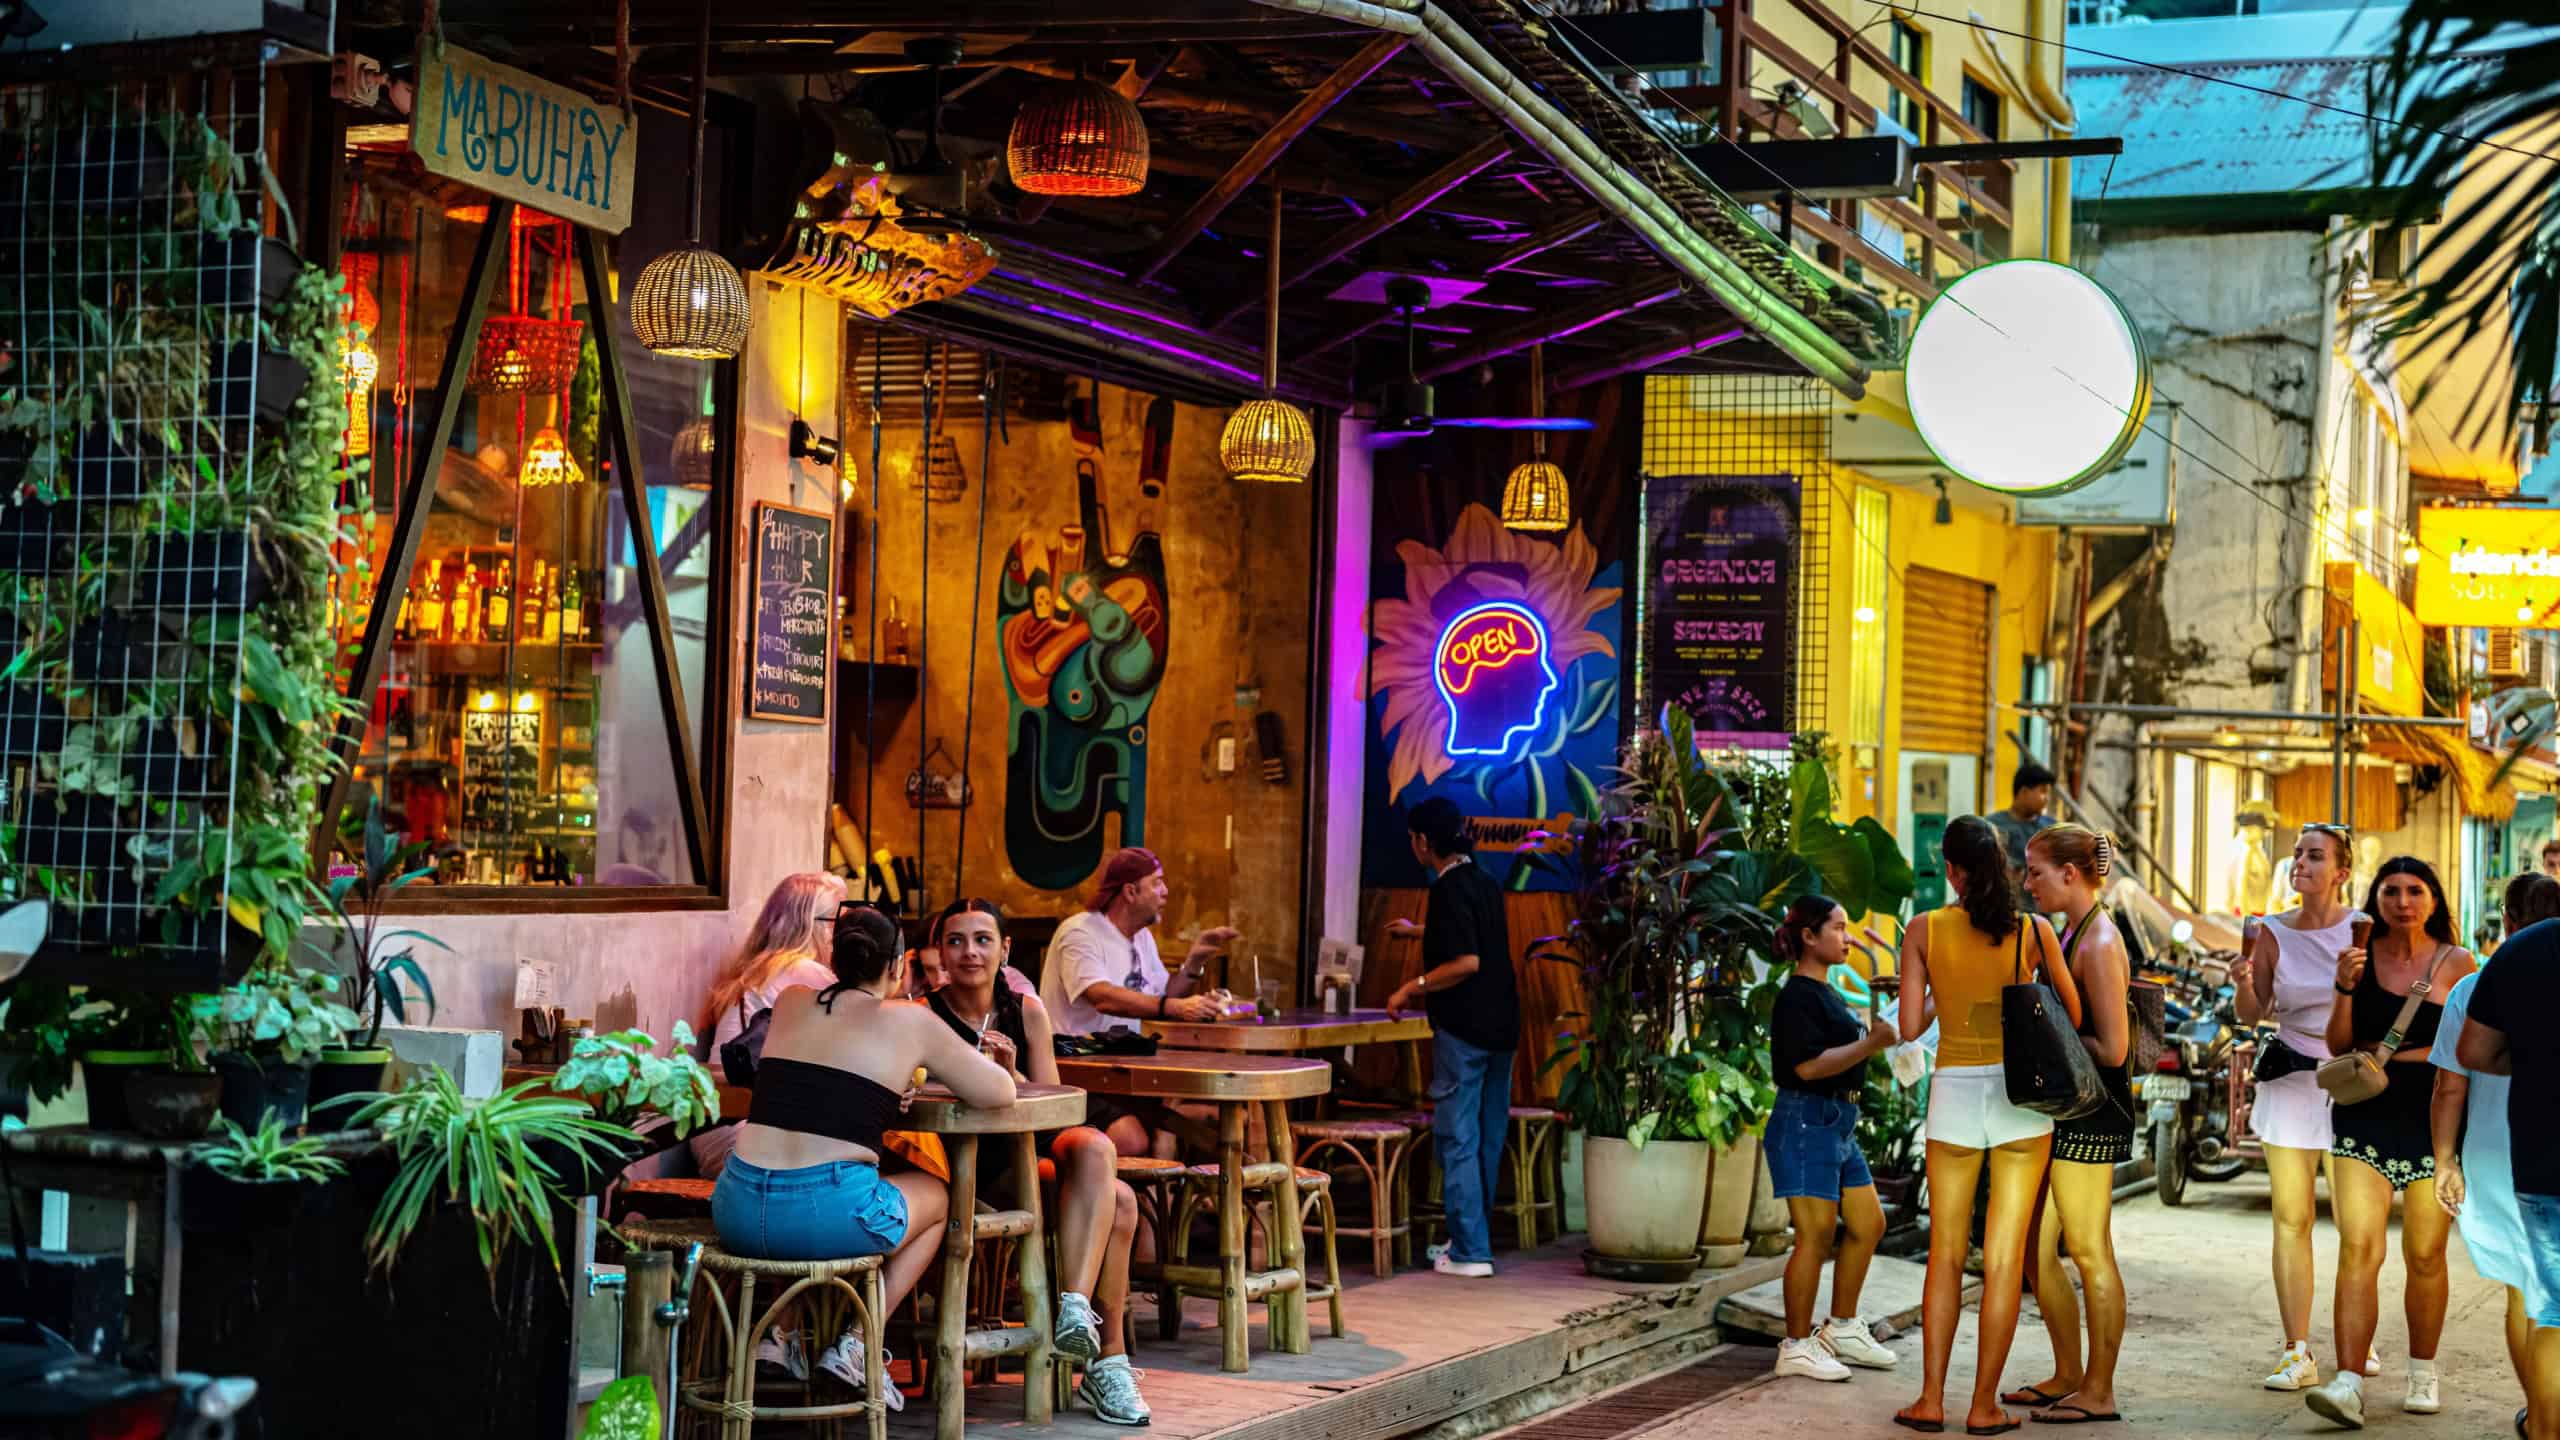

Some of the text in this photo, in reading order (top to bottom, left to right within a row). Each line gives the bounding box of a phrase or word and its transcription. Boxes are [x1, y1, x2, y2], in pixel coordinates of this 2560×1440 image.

[436, 64, 625, 210] MABUHAY
[769, 520, 825, 559] HAPPY
[1662, 559, 1776, 584] ORGANICA
[1451, 621, 1517, 665] OPEN
[1673, 620, 1766, 641] SATURDAY
